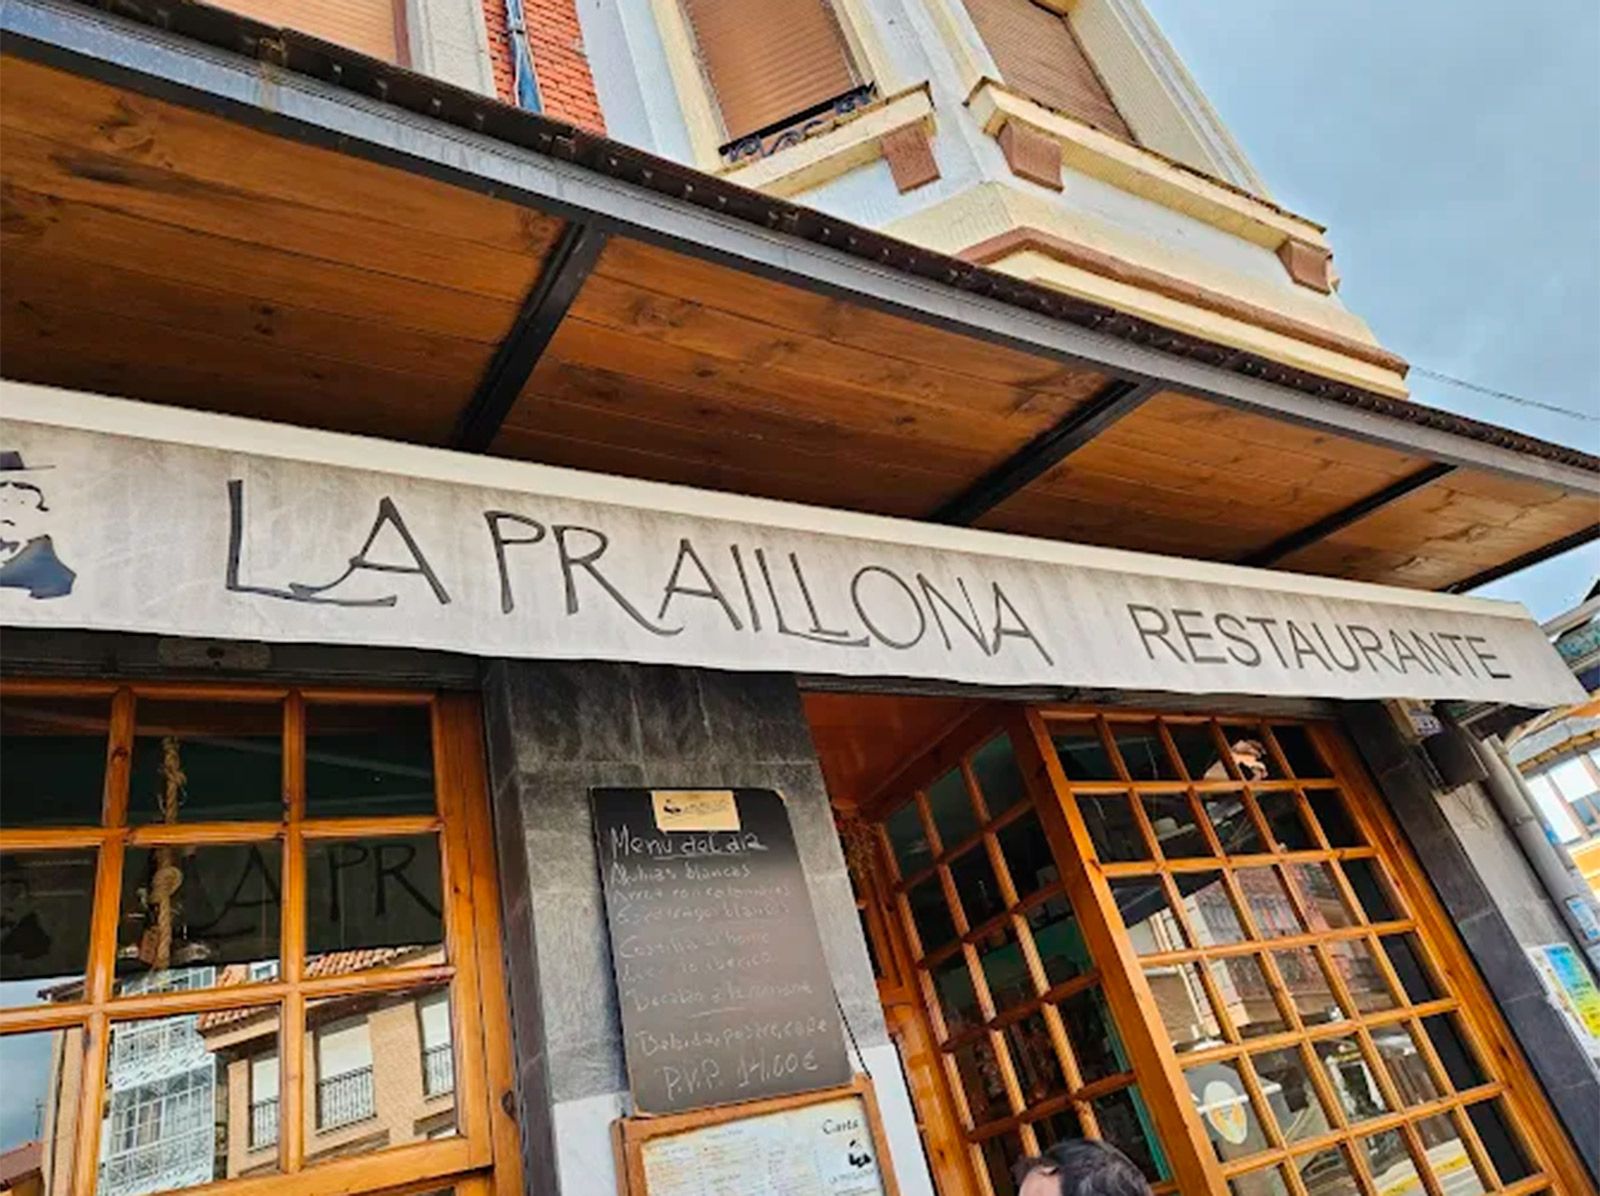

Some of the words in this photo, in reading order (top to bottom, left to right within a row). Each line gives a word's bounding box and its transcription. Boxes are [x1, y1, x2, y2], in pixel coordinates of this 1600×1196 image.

[226, 478, 452, 607] LA
[484, 510, 1054, 667] PRAILLONA
[1126, 603, 1512, 679] RESTAURANTE
[610, 824, 673, 858] Menu
